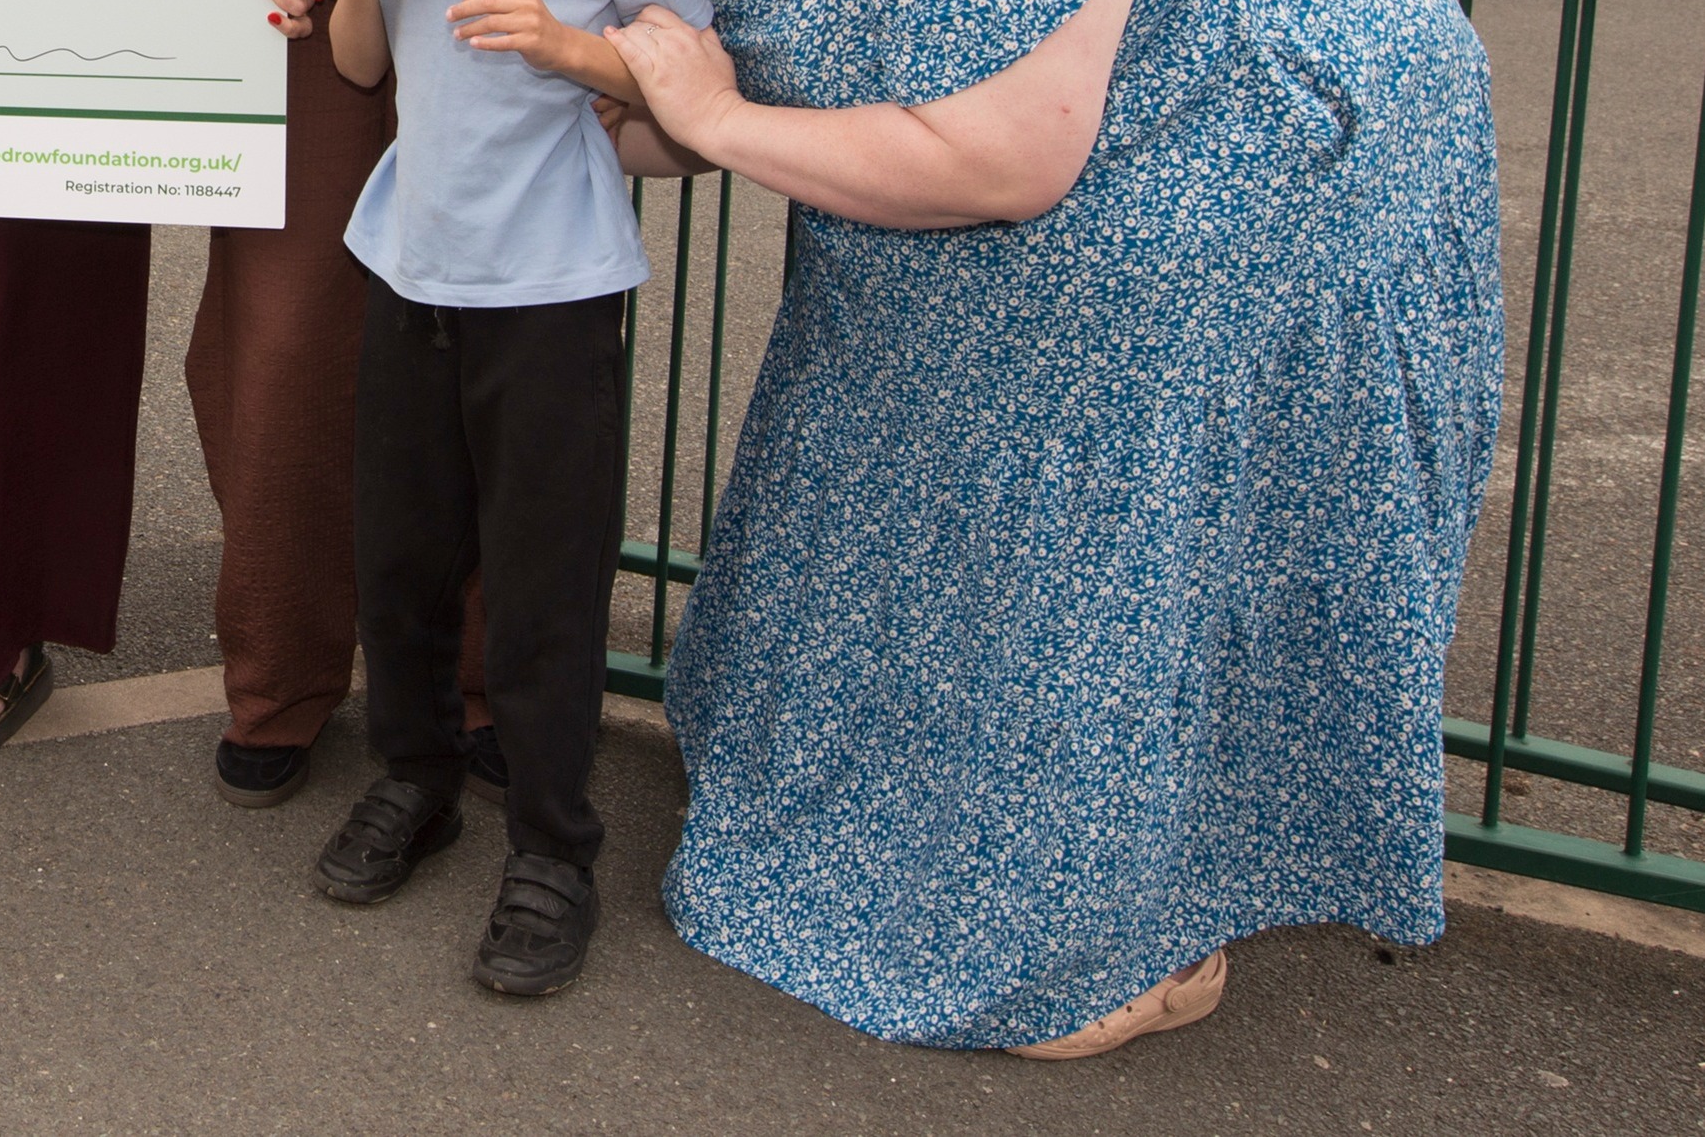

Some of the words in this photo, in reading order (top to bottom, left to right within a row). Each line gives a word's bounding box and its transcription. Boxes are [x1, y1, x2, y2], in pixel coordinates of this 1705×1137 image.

[65, 180, 153, 196] Registration
[156, 184, 181, 196] No:
[184, 184, 242, 199] 1188447
